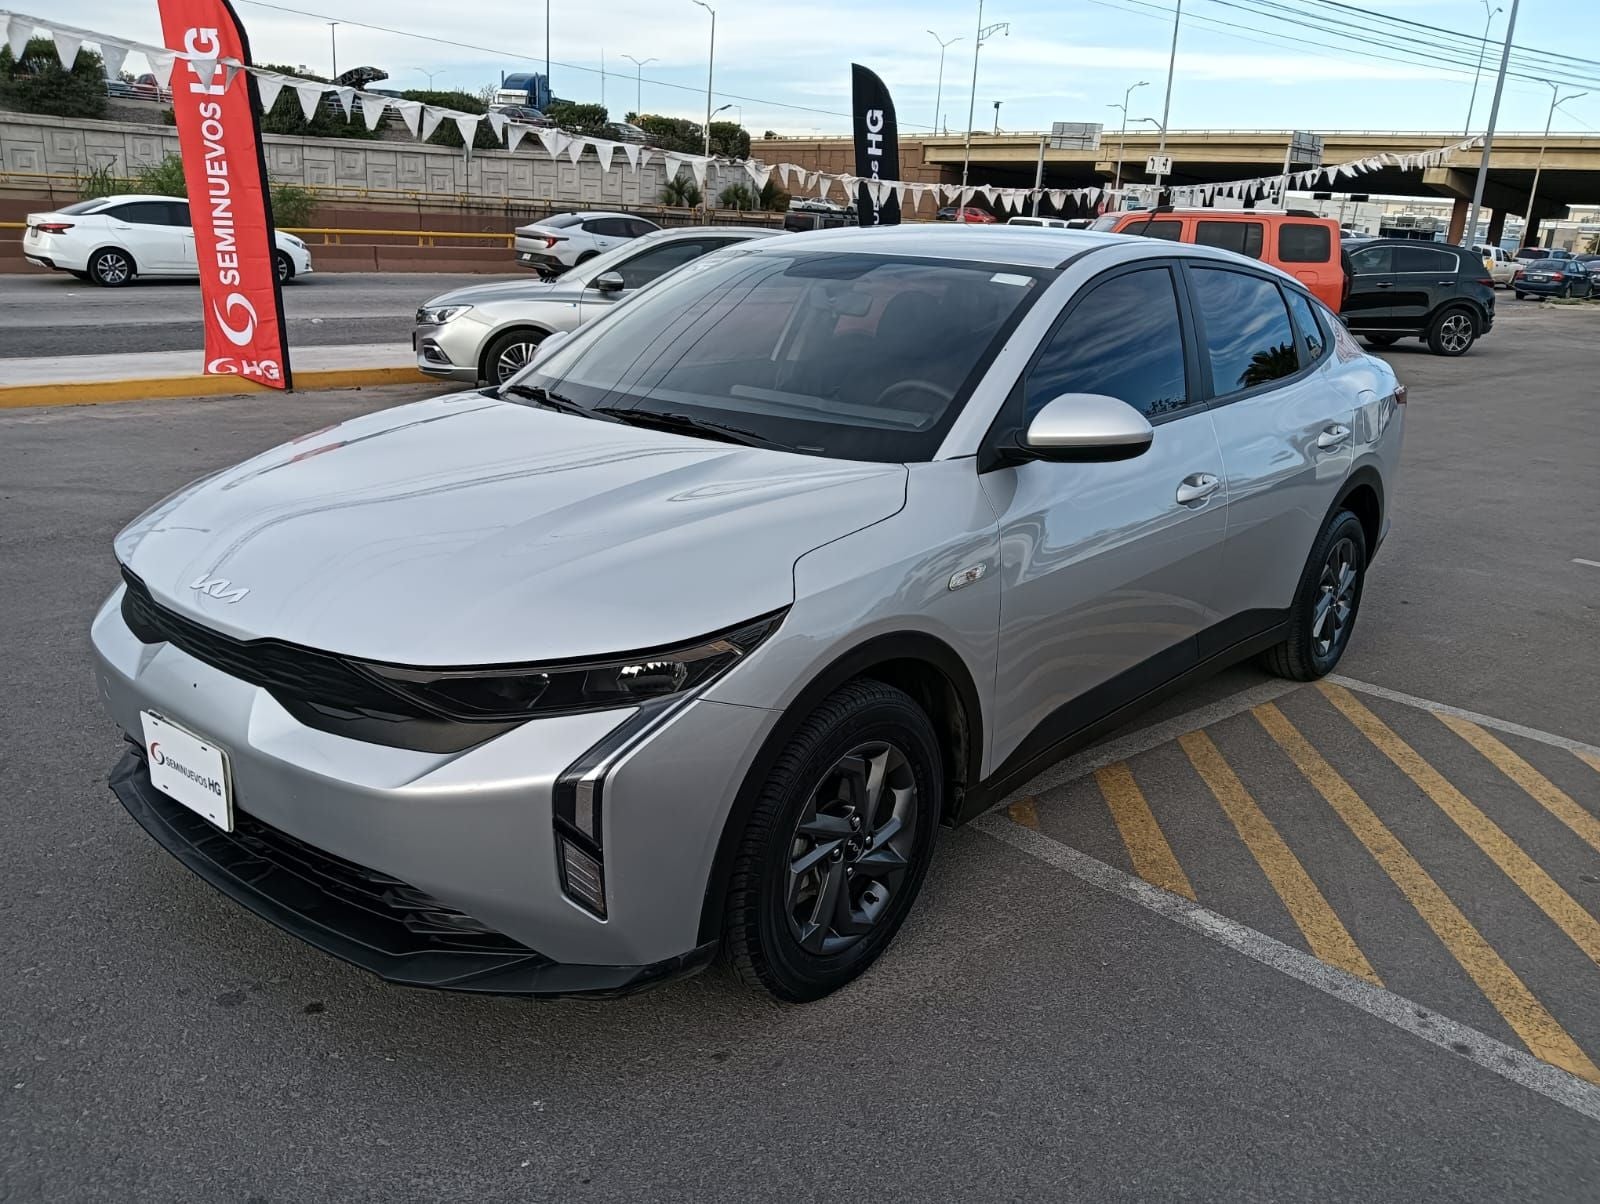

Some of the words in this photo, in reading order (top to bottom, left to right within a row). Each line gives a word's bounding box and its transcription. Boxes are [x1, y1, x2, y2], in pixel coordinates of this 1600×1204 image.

[184, 27, 225, 95] HG
[866, 109, 883, 156] HG
[200, 102, 240, 286] SEMINUEVOS
[241, 359, 280, 380] HG
[165, 756, 207, 789] SEMINUEVOS
[207, 777, 222, 796] HG
